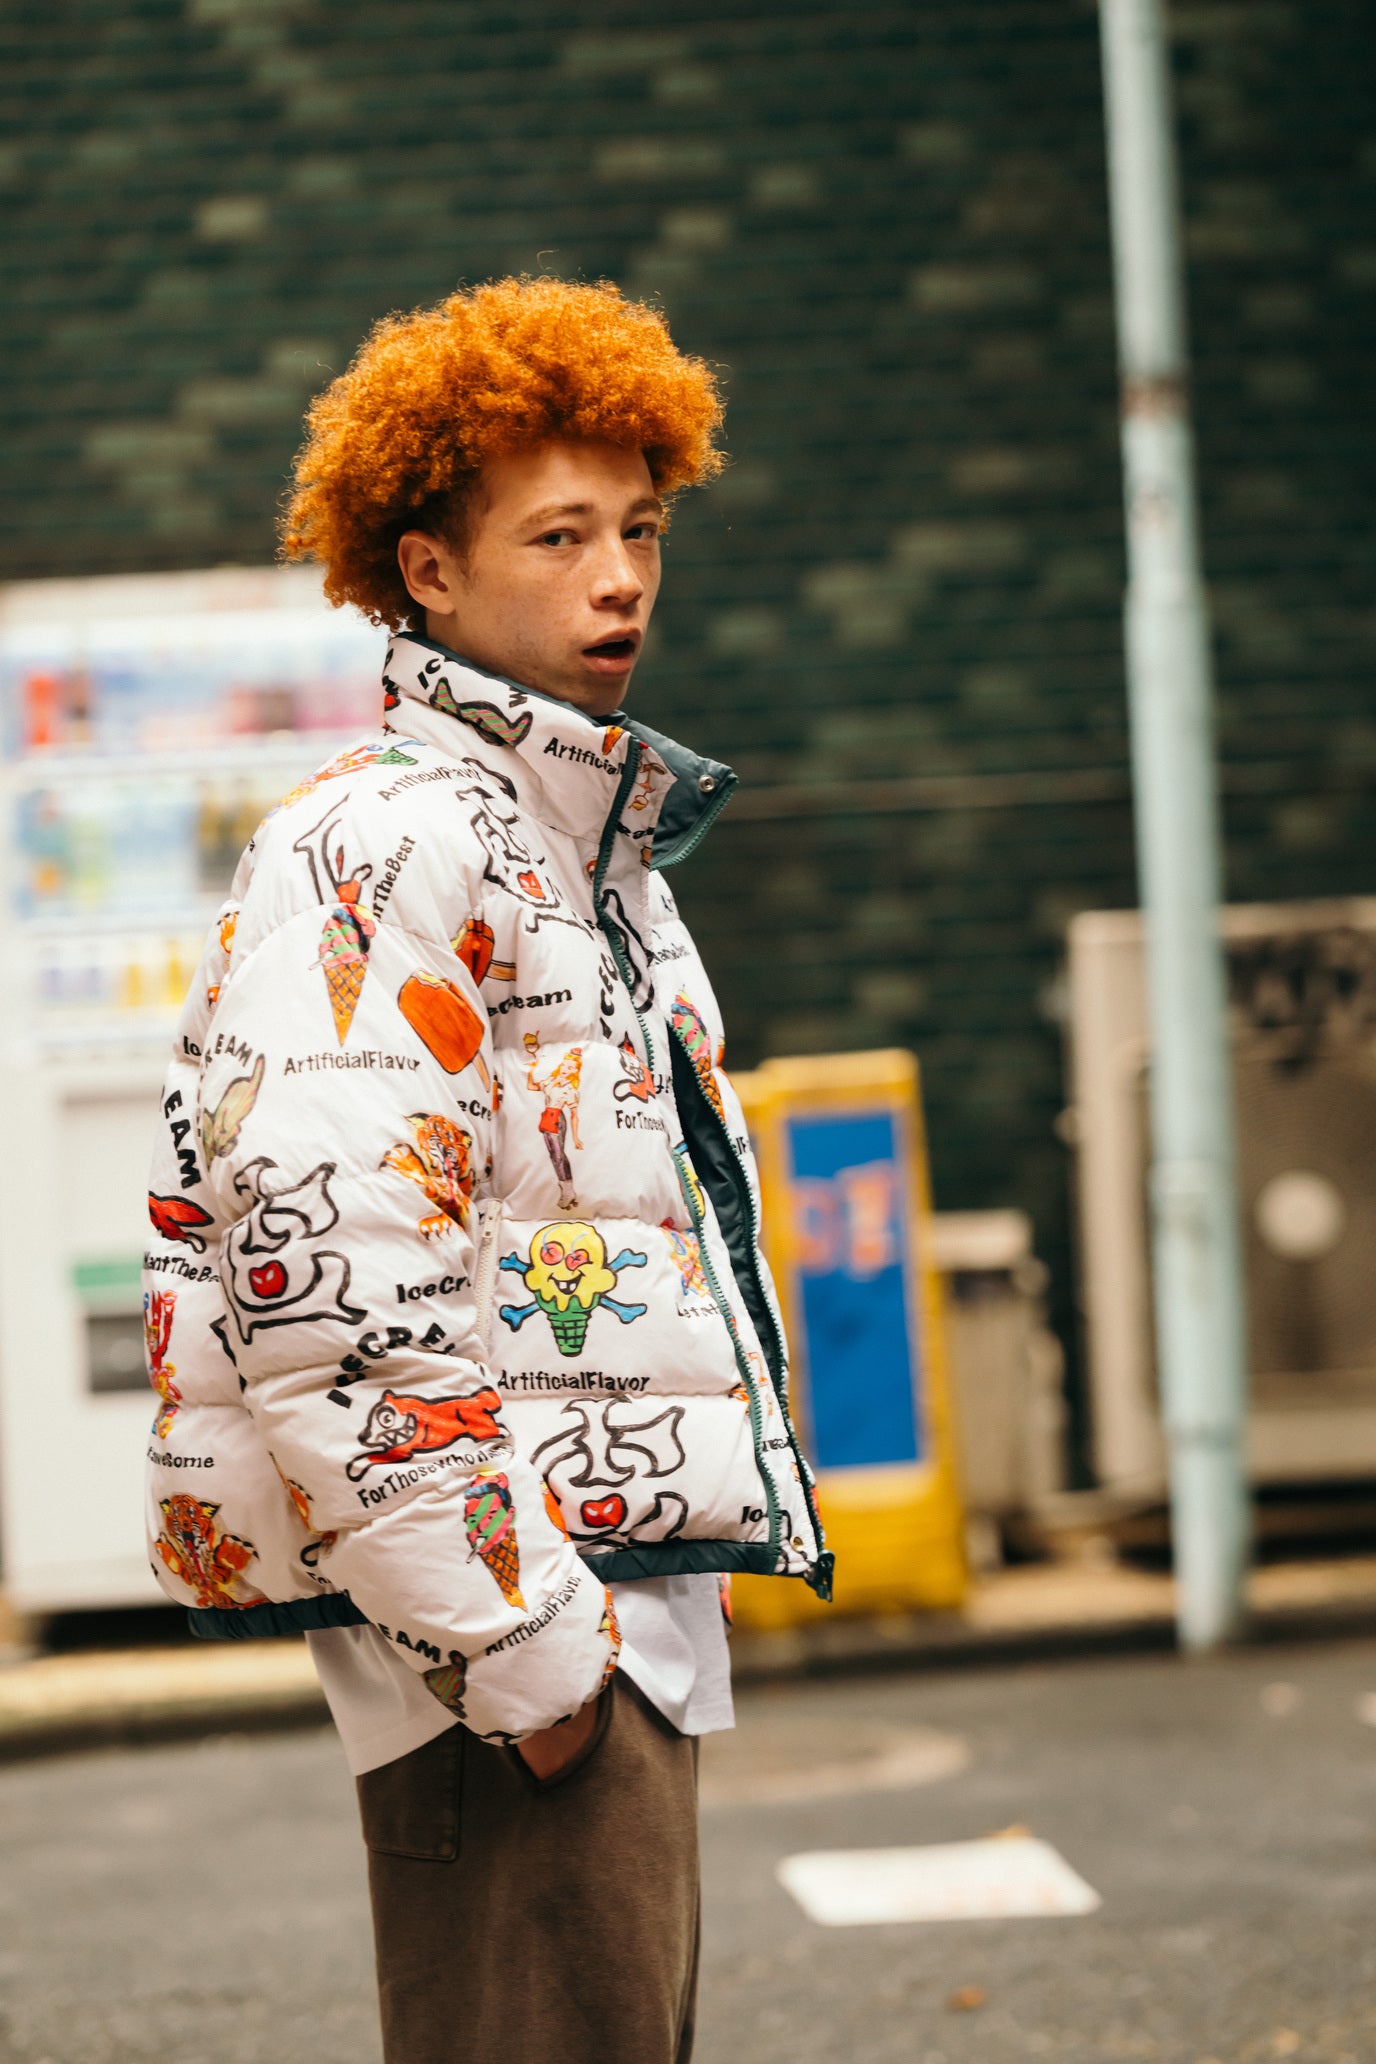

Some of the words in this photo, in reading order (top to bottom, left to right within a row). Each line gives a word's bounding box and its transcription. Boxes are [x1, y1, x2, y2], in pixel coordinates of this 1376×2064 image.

[543, 737, 625, 775] Artificial
[396, 1275, 471, 1304] IceCr
[498, 1369, 650, 1391] ArtificialFlavor
